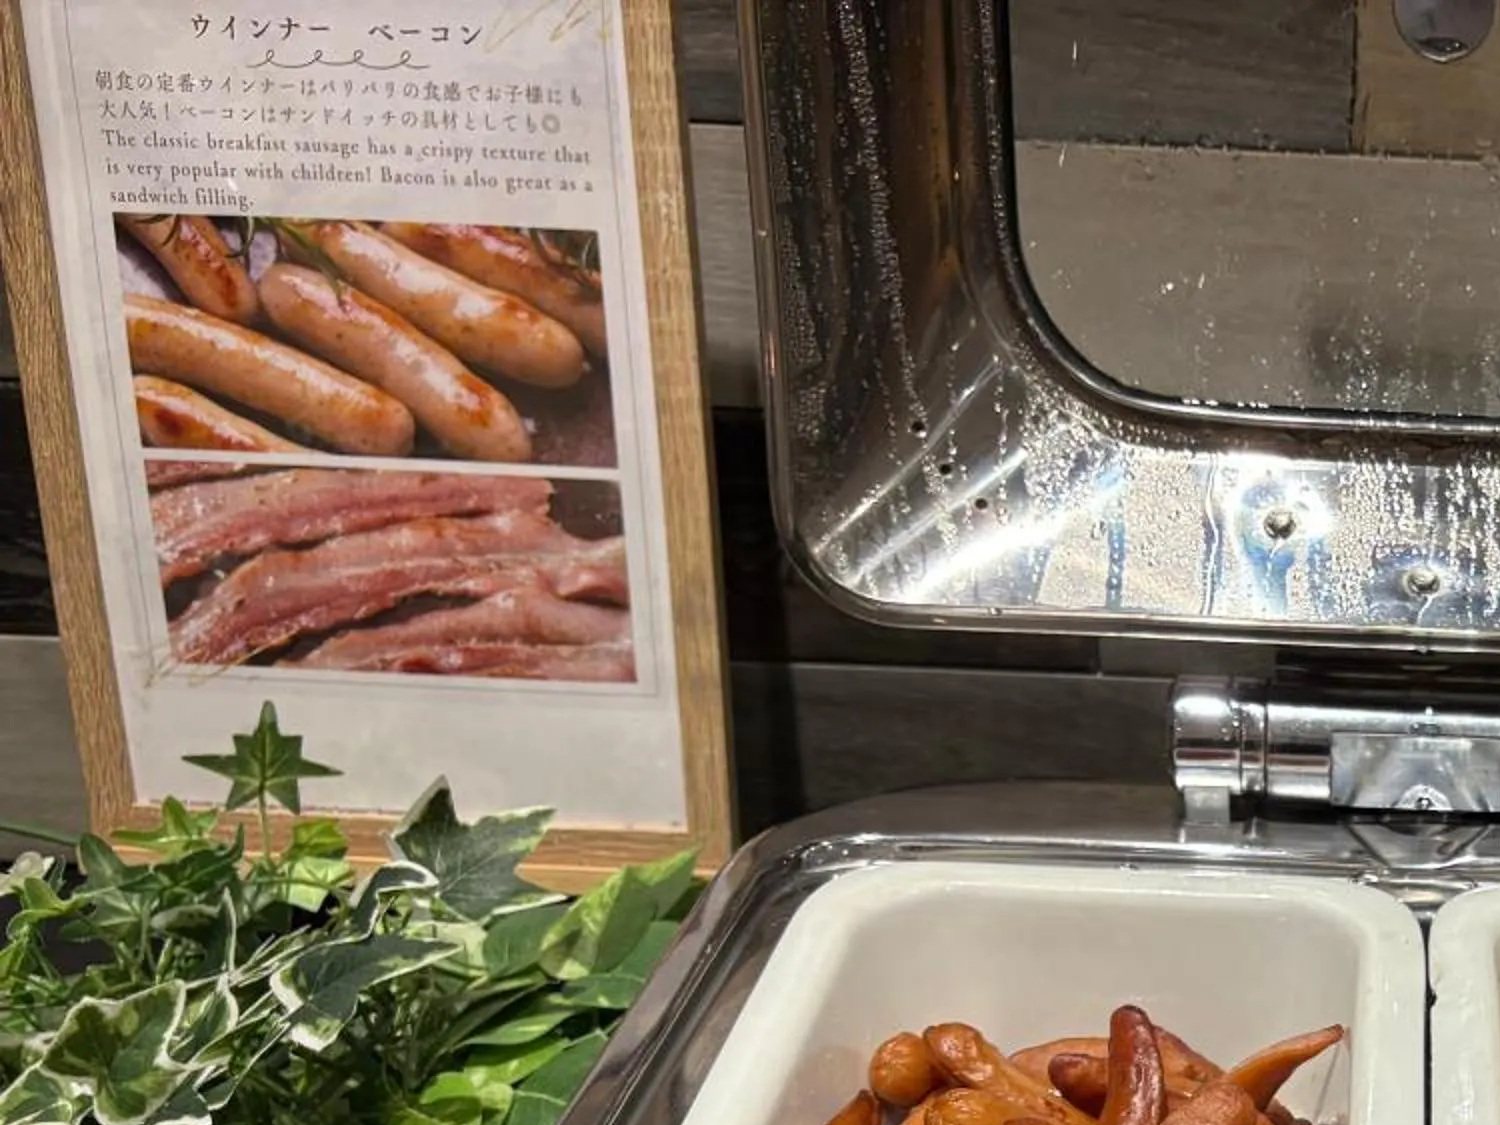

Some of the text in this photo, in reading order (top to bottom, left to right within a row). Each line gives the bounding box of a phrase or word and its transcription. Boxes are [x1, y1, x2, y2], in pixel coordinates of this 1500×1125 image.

[192, 14, 482, 45] ウインナー ベーコン
[101, 129, 592, 165] The classic breakfast sausage has a crispy texture that
[106, 158, 594, 195] is very popular with children! Bacon is also great as a
[110, 187, 255, 211] sandwich filling.
